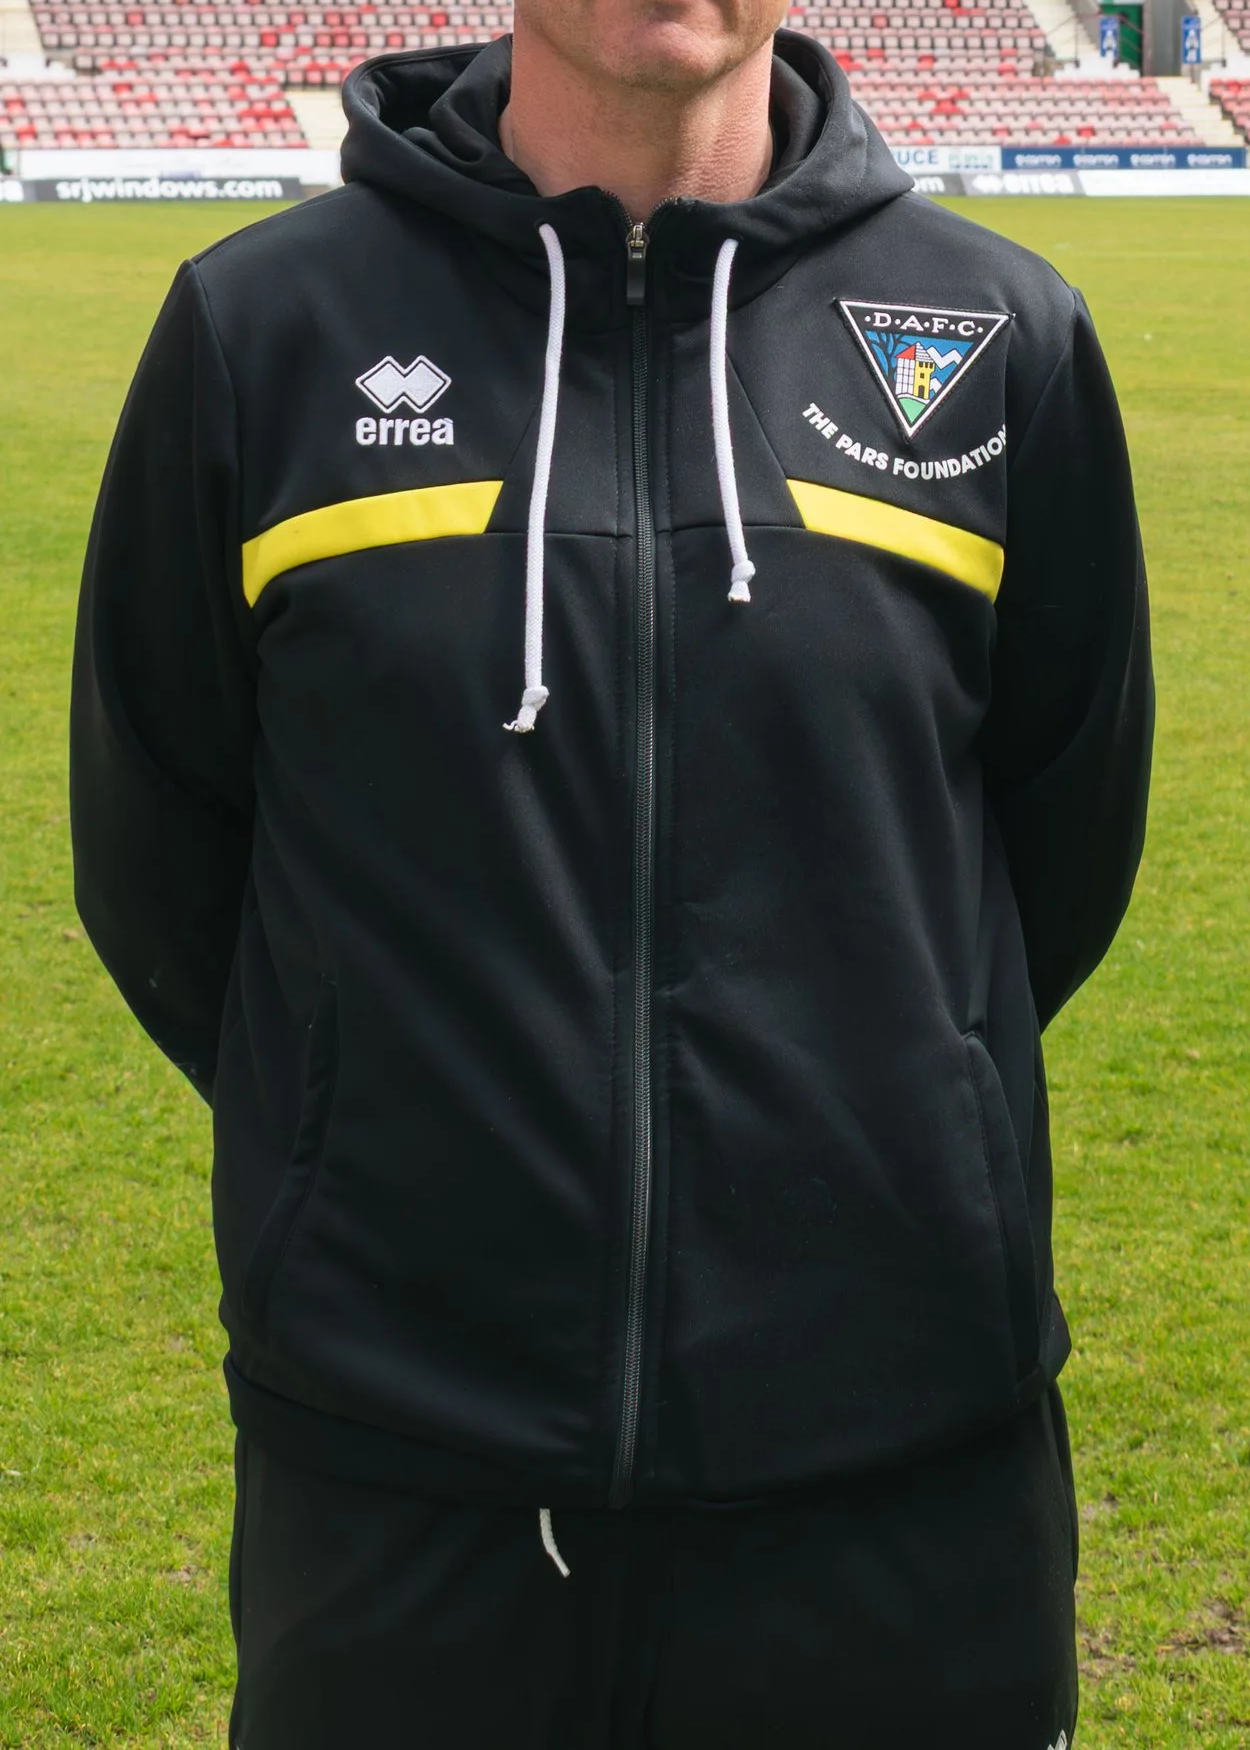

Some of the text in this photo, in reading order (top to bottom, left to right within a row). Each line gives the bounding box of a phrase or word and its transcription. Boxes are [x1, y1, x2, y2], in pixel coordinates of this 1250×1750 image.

[897, 149, 939, 166] UCE
[56, 176, 282, 203] srjwindows.com
[802, 402, 839, 439] THE
[835, 433, 890, 471] PARS
